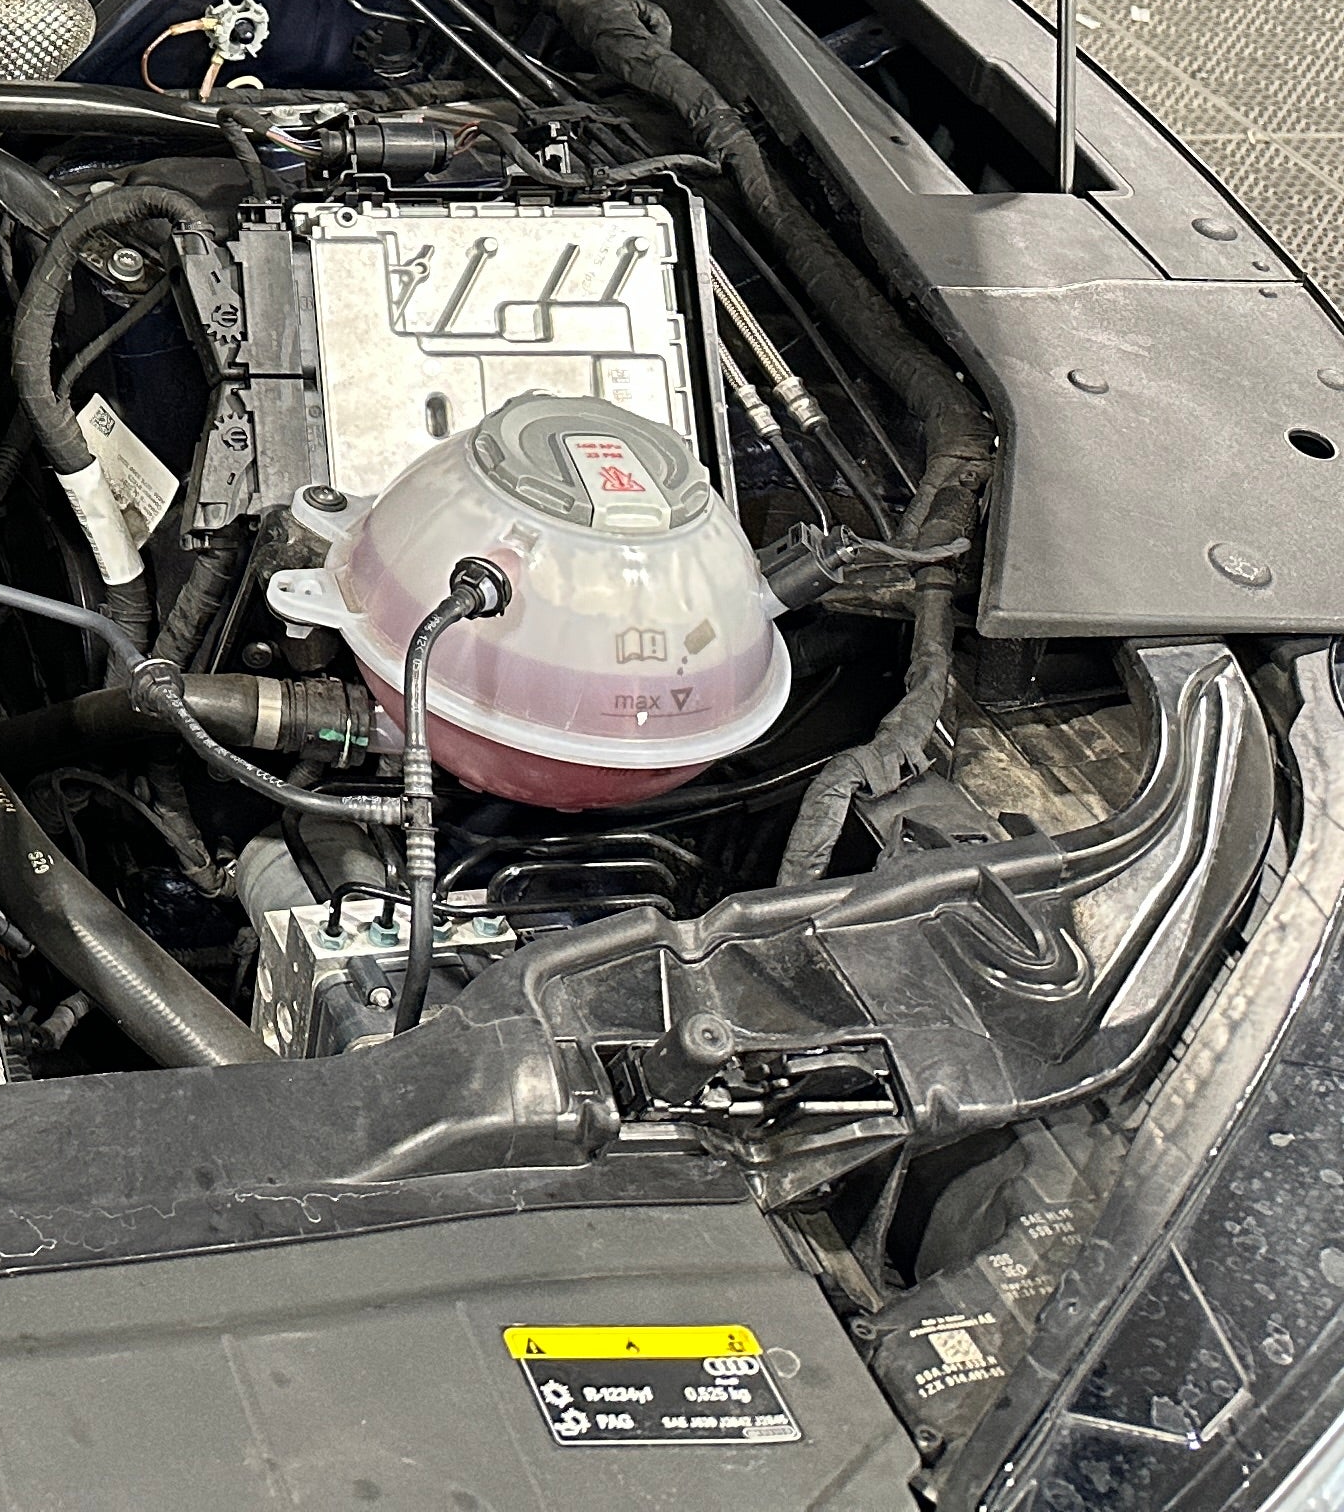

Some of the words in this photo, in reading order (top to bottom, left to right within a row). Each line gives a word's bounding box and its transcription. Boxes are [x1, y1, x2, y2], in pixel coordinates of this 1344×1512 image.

[613, 692, 663, 711] max
[729, 1386, 753, 1404] kg
[595, 1413, 635, 1430] PAG
